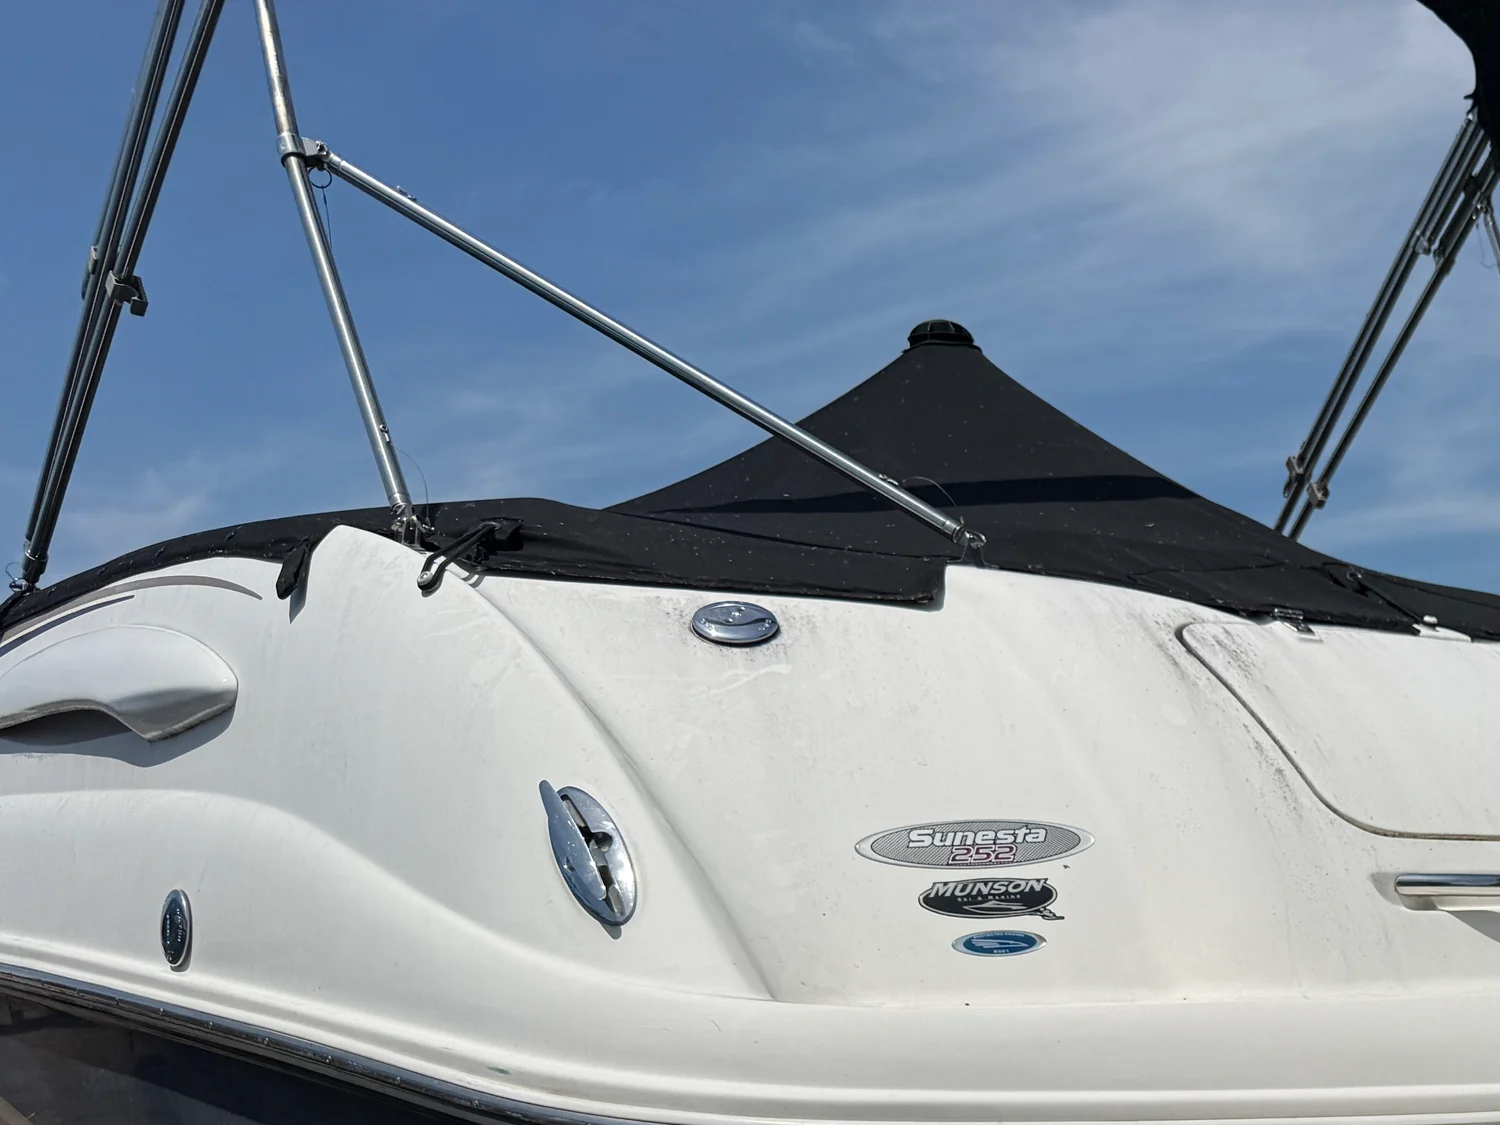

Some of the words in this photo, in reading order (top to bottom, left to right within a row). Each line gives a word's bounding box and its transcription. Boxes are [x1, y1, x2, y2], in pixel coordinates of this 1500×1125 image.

[908, 825, 1047, 848] Sunesta
[948, 845, 1016, 864] 252
[928, 880, 1045, 898] MUNSON
